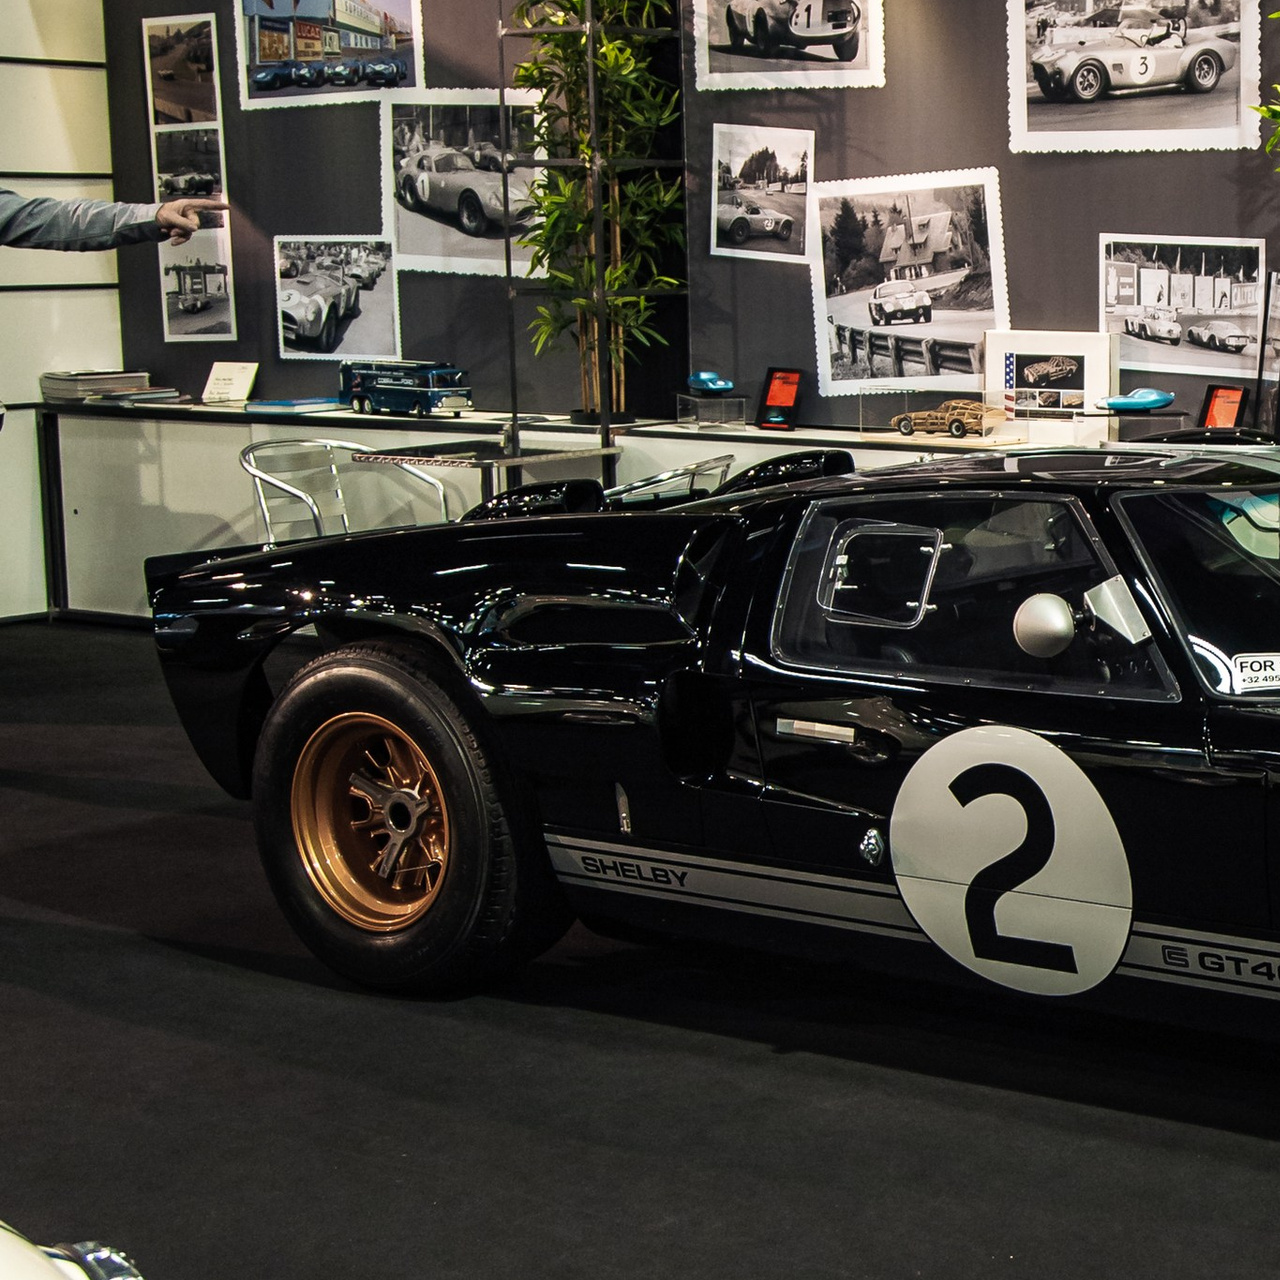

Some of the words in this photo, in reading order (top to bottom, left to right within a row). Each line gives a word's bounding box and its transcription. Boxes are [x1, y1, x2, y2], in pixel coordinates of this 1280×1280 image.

[804, 4, 812, 28] 1
[1138, 56, 1148, 75] 3
[1240, 661, 1275, 673] FOR
[1242, 676, 1259, 684] +32
[581, 856, 688, 887] SHELBY
[948, 762, 1079, 974] 2
